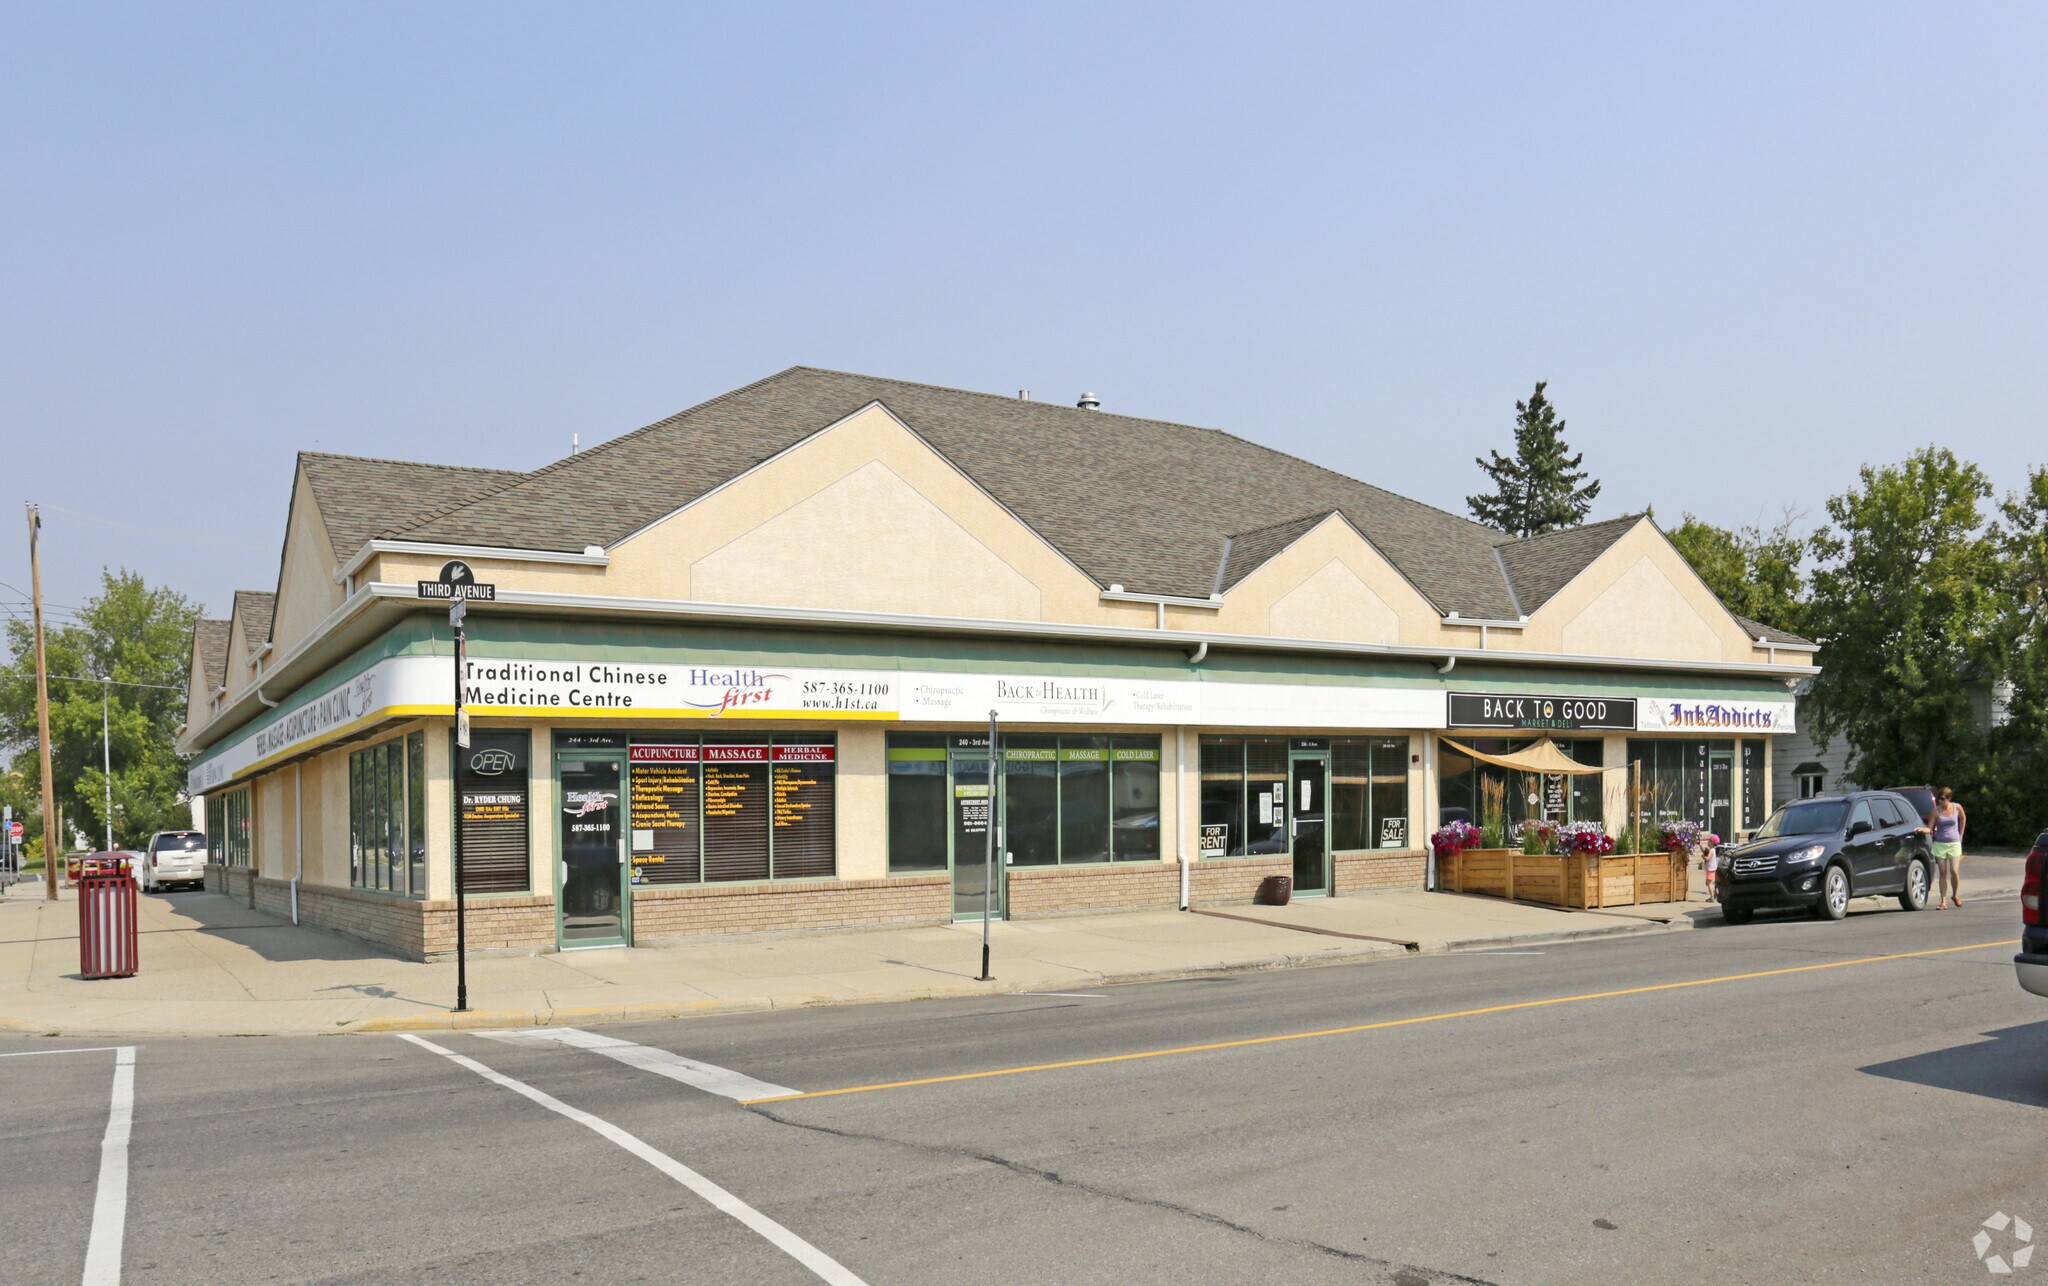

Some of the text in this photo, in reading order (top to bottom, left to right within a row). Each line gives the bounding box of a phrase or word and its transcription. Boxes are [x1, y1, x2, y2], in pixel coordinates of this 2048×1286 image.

[422, 584, 491, 598] THIRD AVENUE
[466, 662, 667, 684] Traditional Chinese
[689, 669, 764, 687] Health
[802, 682, 889, 696] 587-365-1100
[920, 685, 964, 696] Chiropractic
[466, 687, 560, 706] Medicine
[569, 690, 632, 706] Centre
[710, 686, 774, 716] first
[802, 696, 878, 710] www.h1st.ca
[923, 697, 952, 708] Massage
[286, 704, 316, 744] ACUPUNCTURE
[320, 696, 332, 728] PAIN
[333, 686, 350, 723] CLINIC
[1484, 699, 1606, 720] BACK TO GOOD
[1521, 719, 1549, 727] MARKET
[1558, 720, 1573, 728] DELI
[632, 748, 697, 759] ACUPUNCTURE
[709, 750, 762, 759] MASSAGE
[1006, 751, 1056, 759] CHIROPRACTIC
[470, 754, 515, 770] OPEN
[567, 792, 604, 802] Health
[576, 800, 608, 817] first
[1388, 820, 1400, 828] FOR
[1206, 828, 1220, 836] FOR
[1382, 829, 1404, 840] SALE
[1201, 836, 1226, 848] RENT
